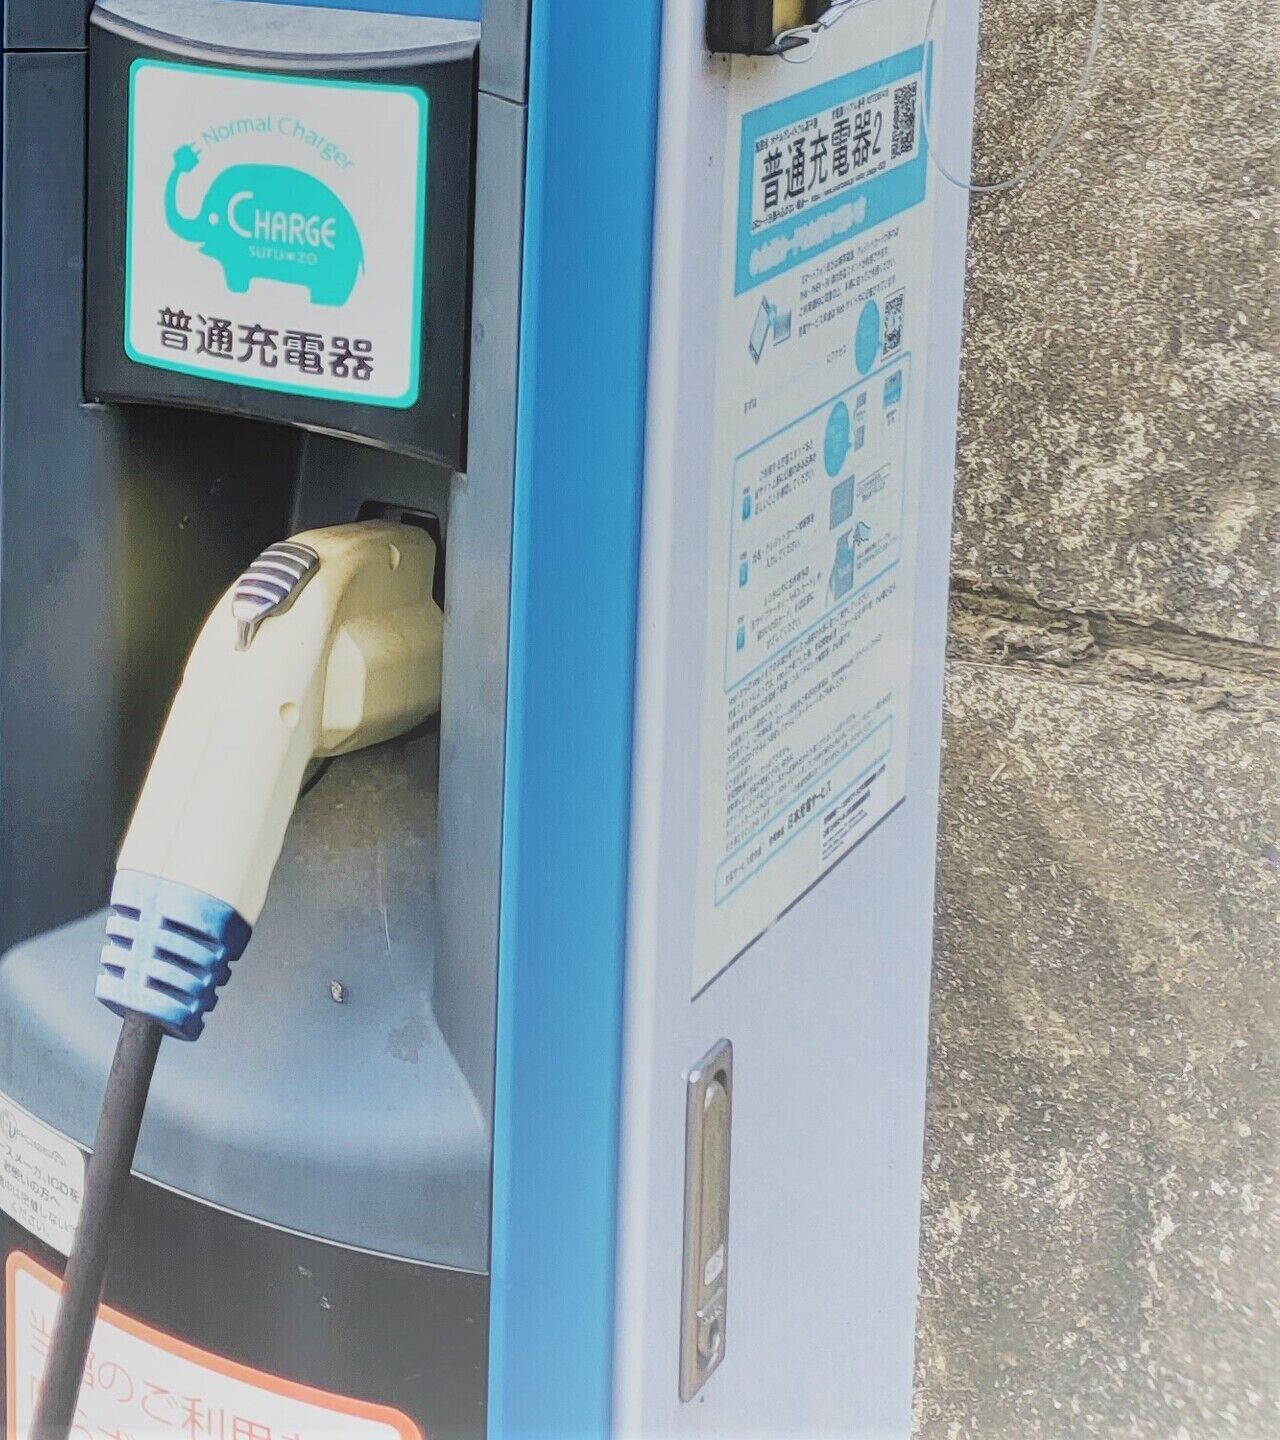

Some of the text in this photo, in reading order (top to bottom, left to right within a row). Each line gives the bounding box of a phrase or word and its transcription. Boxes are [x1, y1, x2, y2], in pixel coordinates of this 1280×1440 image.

[202, 116, 355, 170] Normal Charger
[761, 110, 882, 212] 普通充電器2
[157, 306, 374, 381] 普通充電器
